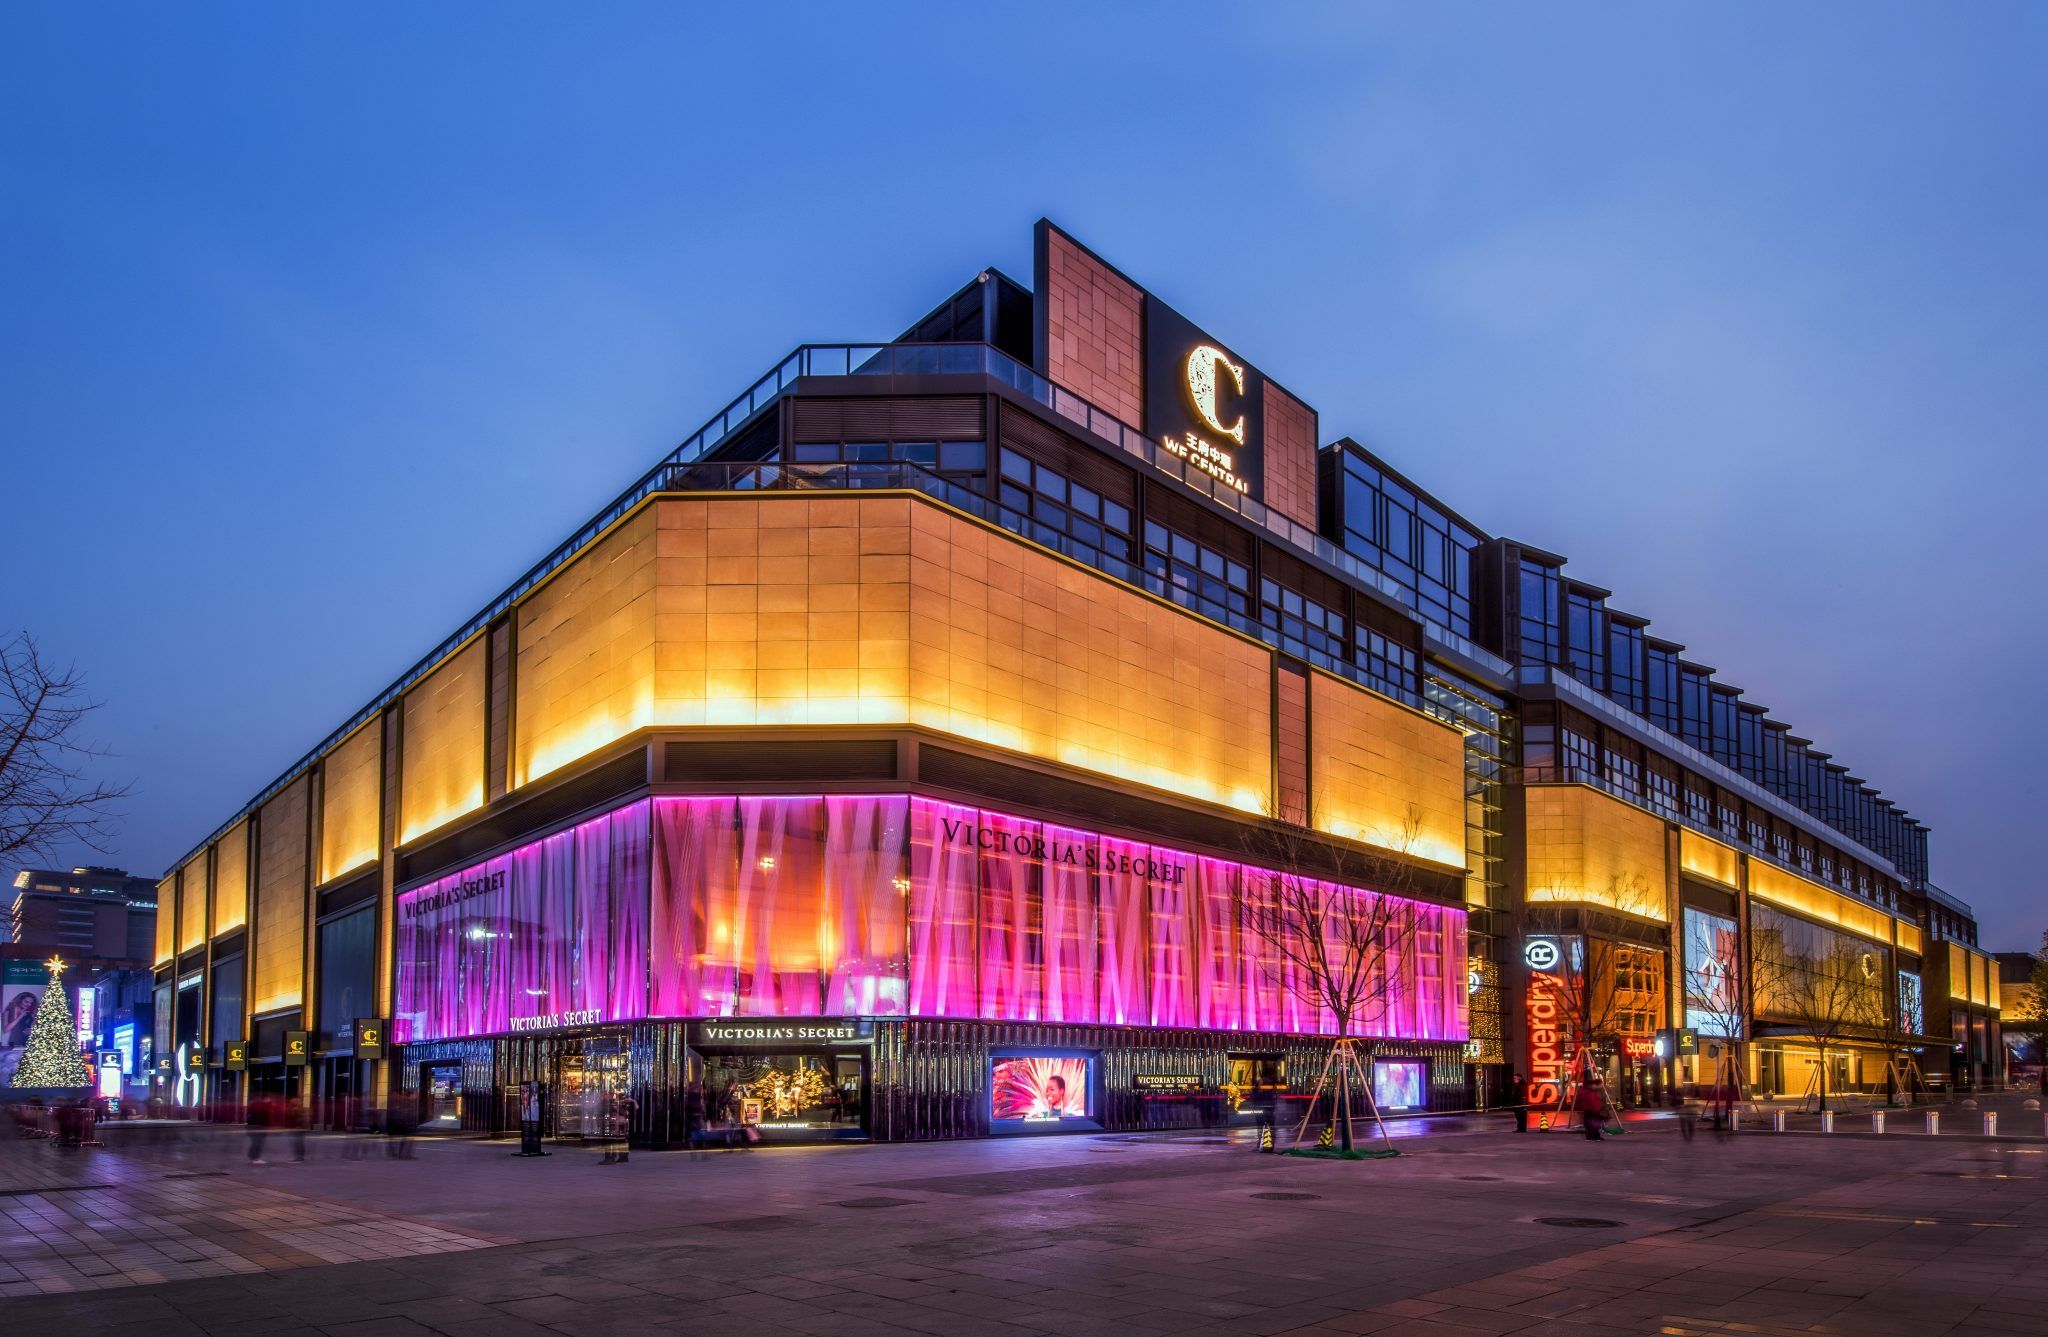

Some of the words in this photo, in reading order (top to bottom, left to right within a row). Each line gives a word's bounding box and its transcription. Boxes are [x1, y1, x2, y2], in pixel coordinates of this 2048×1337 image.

[940, 817, 1096, 869] VICTORIA'S
[1105, 850, 1187, 885] SECRET
[405, 887, 461, 920] VICTORIA'S
[463, 870, 506, 901] SECRET
[510, 1013, 559, 1032] VICTORIA'S
[563, 1008, 602, 1027] SECRET
[706, 1028, 793, 1039] VICTORIA'S
[799, 1027, 855, 1038] SECRET
[1527, 970, 1565, 1105] Superdry
[1626, 1038, 1656, 1057] Superdry
[1138, 1076, 1175, 1084] VICTORIA'S
[1176, 1076, 1200, 1084] SECRET
